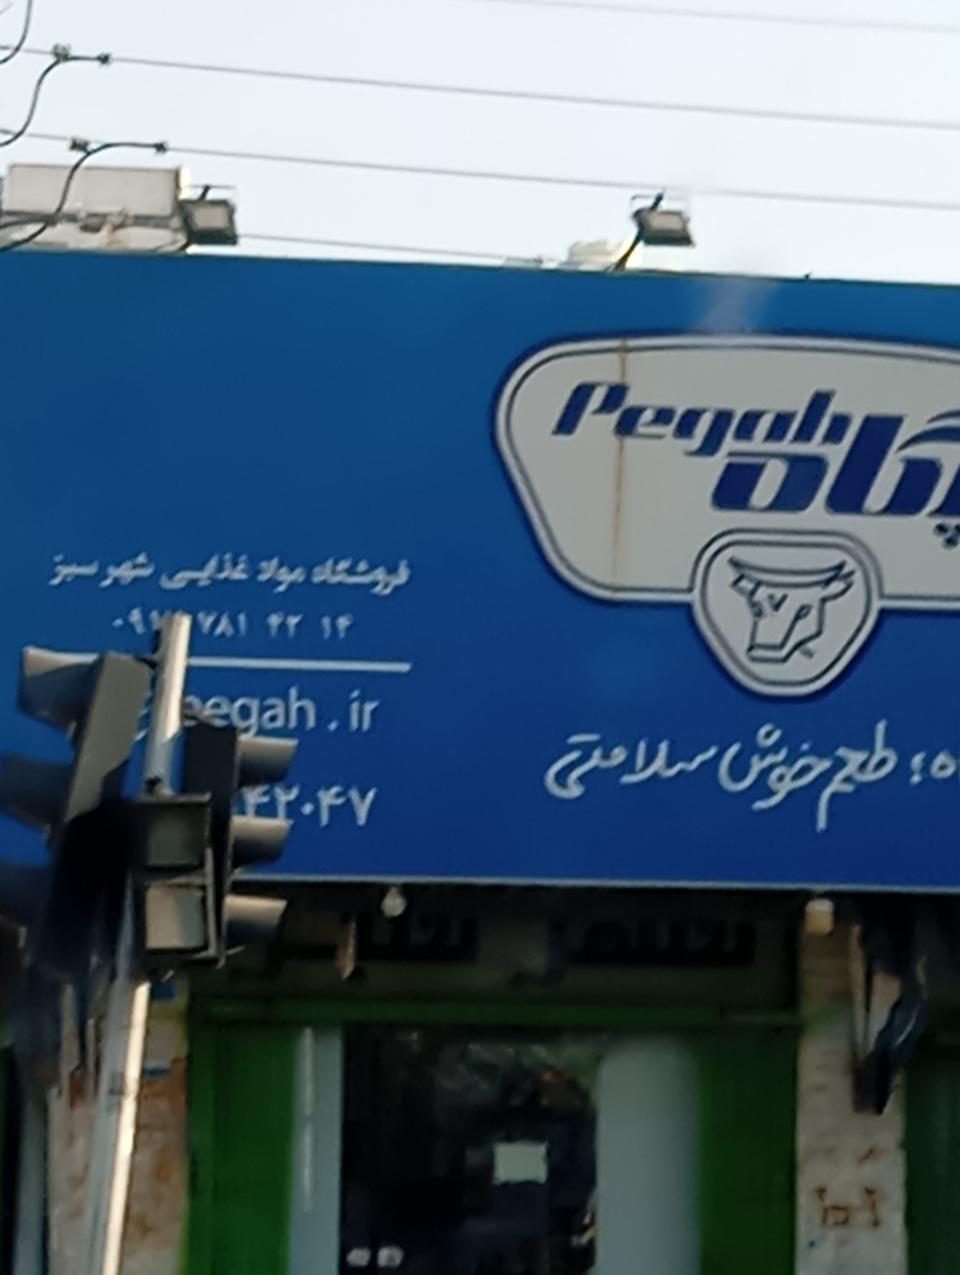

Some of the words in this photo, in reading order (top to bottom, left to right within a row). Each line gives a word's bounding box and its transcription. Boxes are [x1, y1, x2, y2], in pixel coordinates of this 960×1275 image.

[551, 381, 853, 458] Pegah
[49, 555, 98, 585] سبز
[96, 552, 154, 587] شهر
[257, 557, 306, 592] مواد
[311, 558, 410, 595] فروشگاه
[543, 733, 719, 799] سلامتی
[718, 722, 832, 810] خوش
[816, 719, 898, 832] طعم
[240, 784, 377, 828] ۴۲۰۴۷
